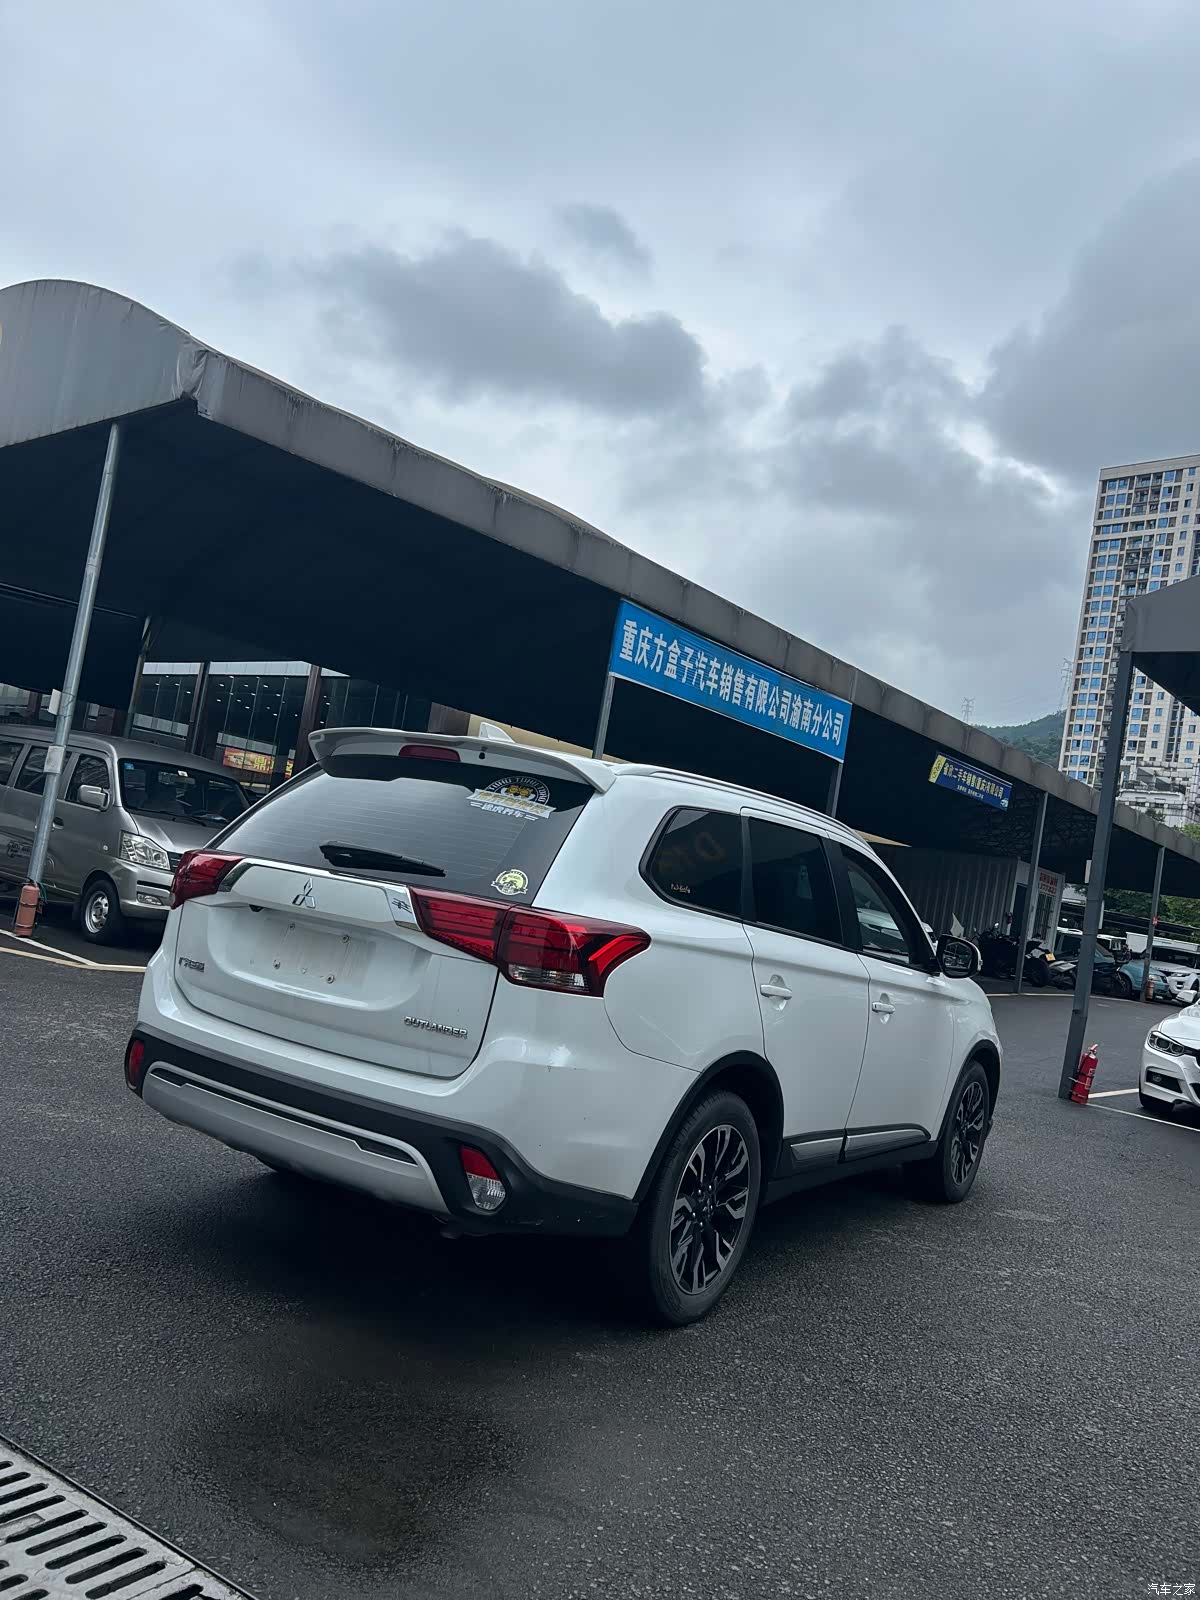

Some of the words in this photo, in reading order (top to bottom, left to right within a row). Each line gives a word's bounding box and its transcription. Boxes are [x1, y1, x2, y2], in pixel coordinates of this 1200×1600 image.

[619, 619, 844, 746] 重庆方盒子汽车销售有限公司渝南分公司
[404, 1016, 468, 1039] OUTLANDER
